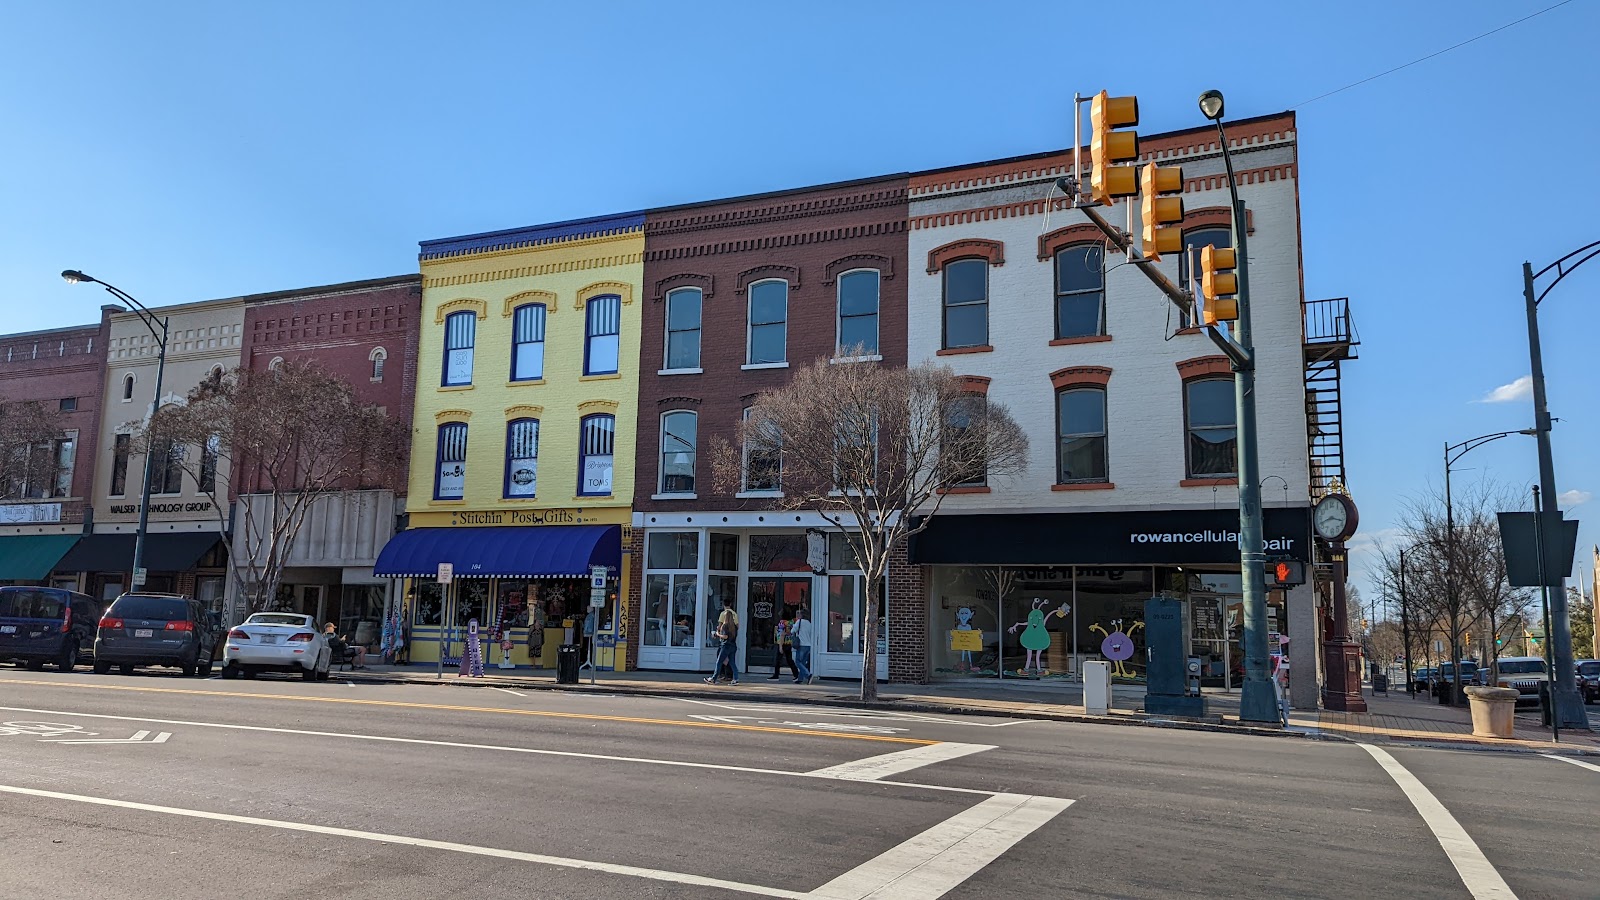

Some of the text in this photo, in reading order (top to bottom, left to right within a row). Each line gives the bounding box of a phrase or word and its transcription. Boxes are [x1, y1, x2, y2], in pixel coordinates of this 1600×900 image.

[588, 478, 609, 487] TOMS
[110, 502, 211, 514] WALSER THNOLOGY GROUP
[510, 511, 537, 524] Post
[544, 509, 573, 523] Gifts
[1237, 536, 1294, 550] rair
